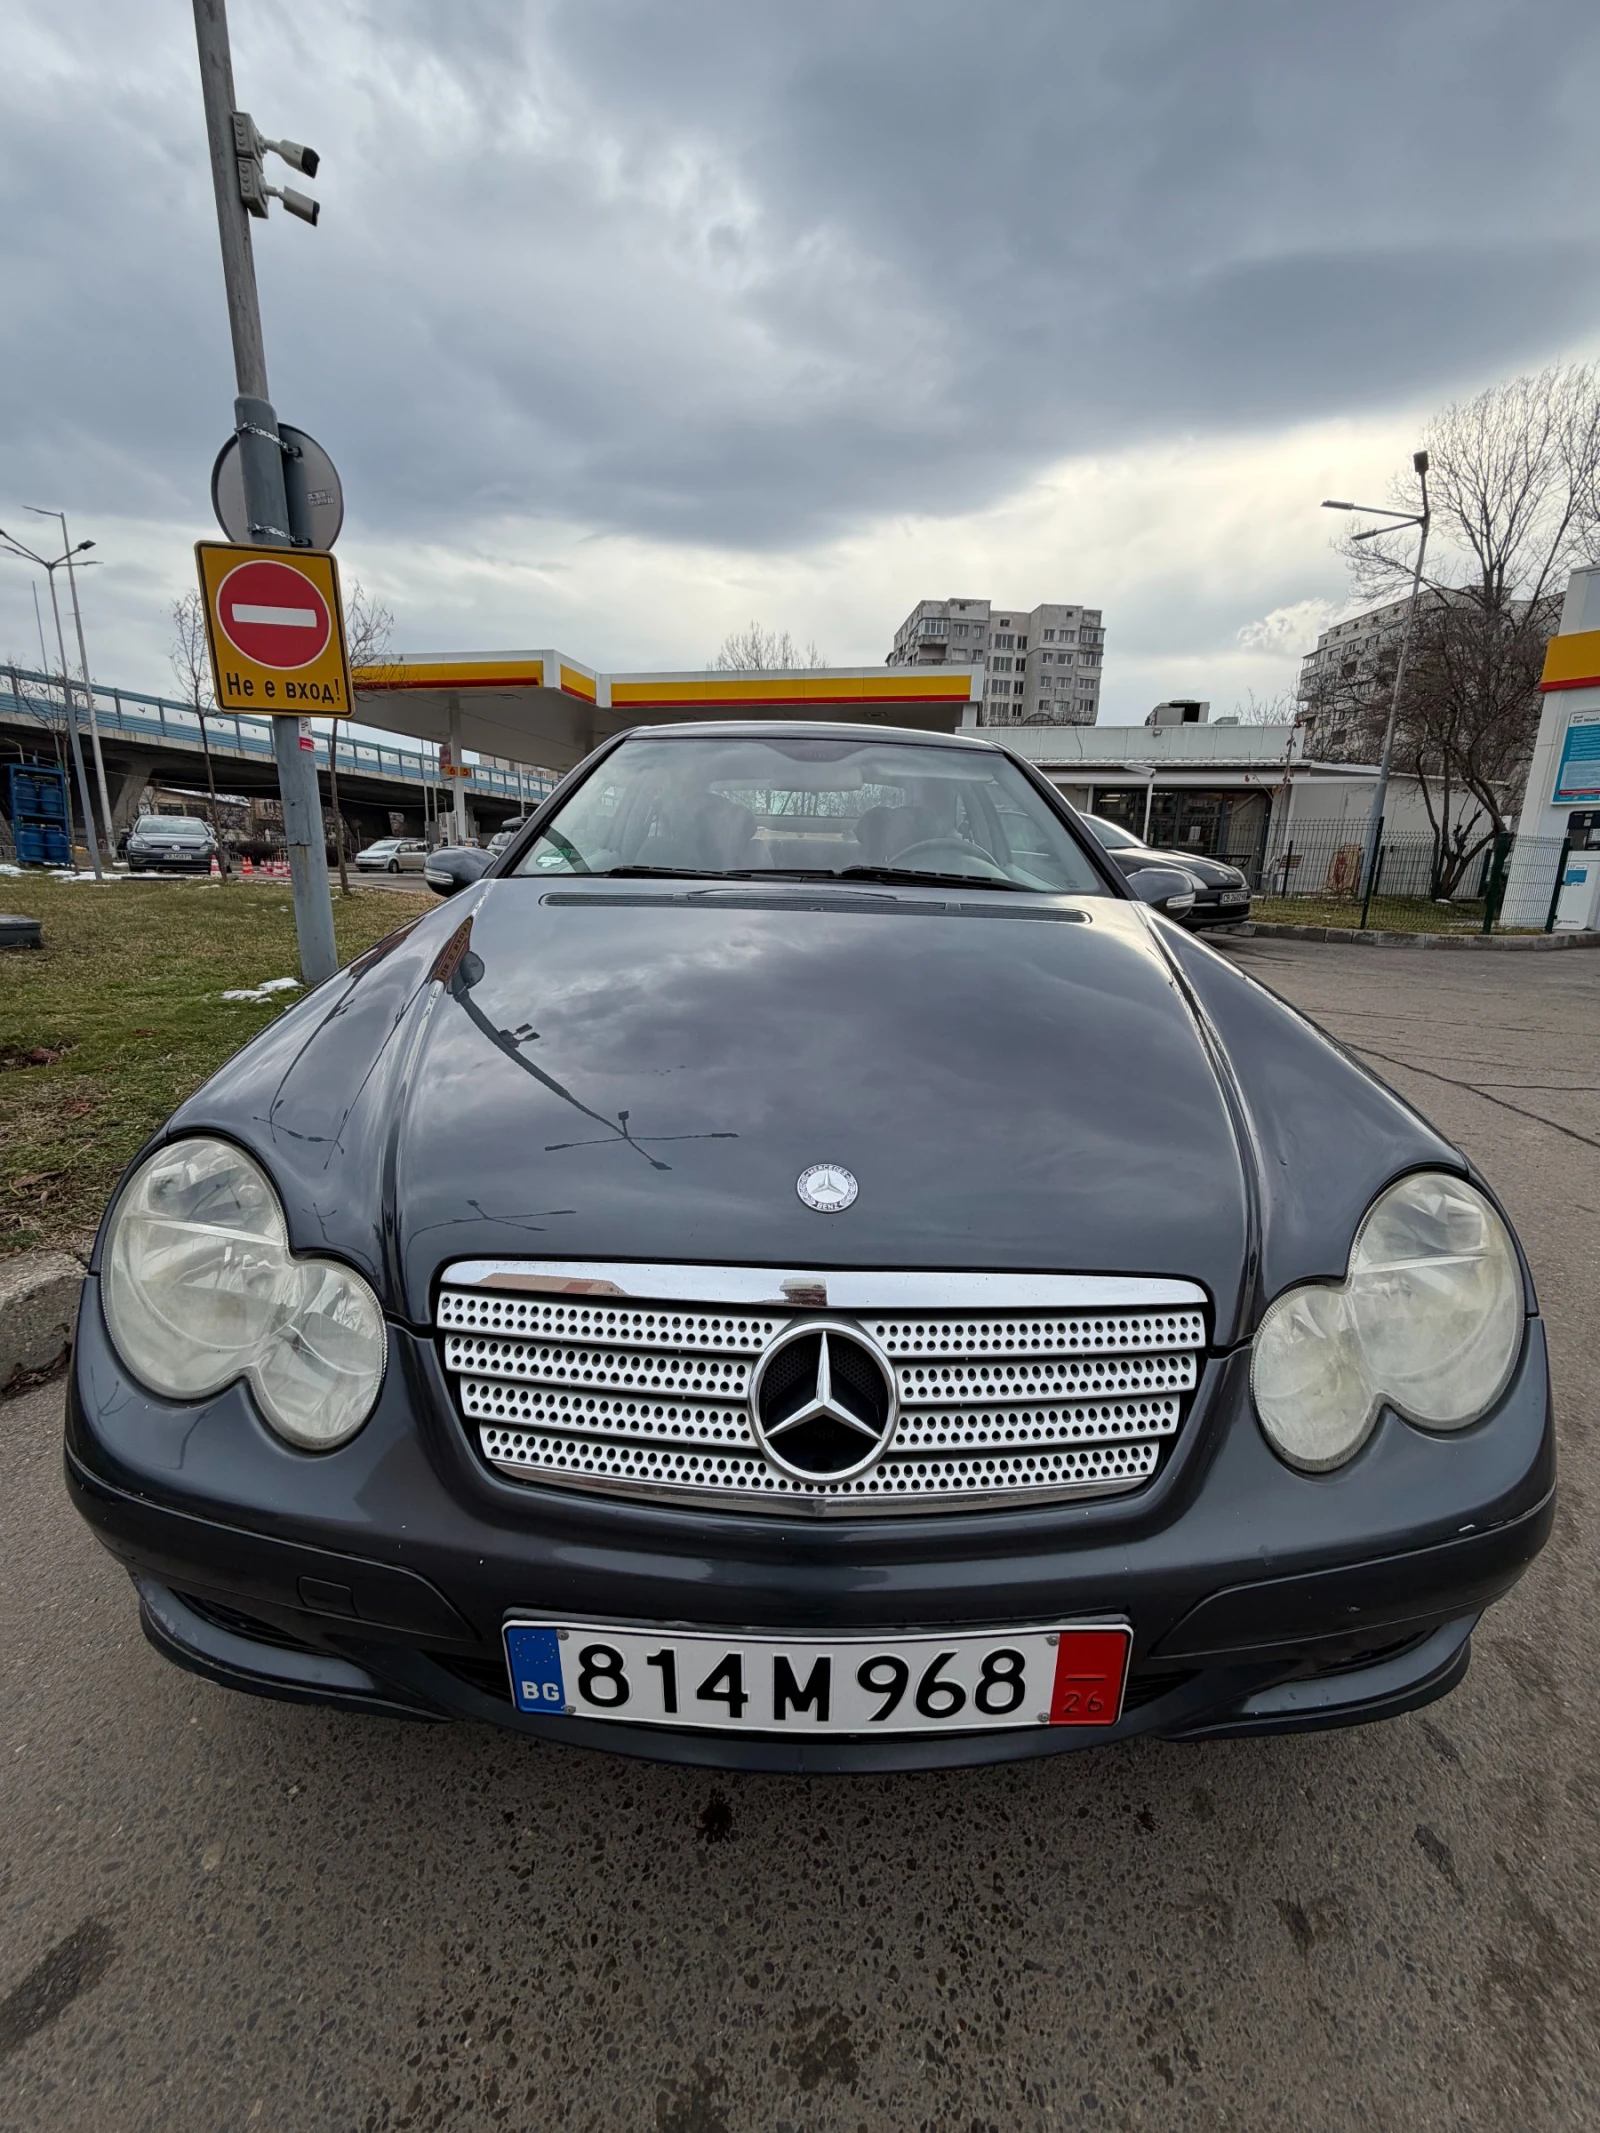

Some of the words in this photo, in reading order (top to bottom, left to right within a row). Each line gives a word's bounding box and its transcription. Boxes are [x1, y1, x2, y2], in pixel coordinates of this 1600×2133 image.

[226, 672, 254, 697] Не
[264, 680, 276, 698] е
[285, 678, 340, 704] вход!
[808, 1164, 848, 1177] MERCEDES
[817, 1202, 840, 1210] BENZ
[521, 1680, 560, 1701] BG
[578, 1643, 749, 1718] 814
[774, 1656, 832, 1721] M
[856, 1648, 1026, 1721] 968
[1063, 1691, 1103, 1714] 26
